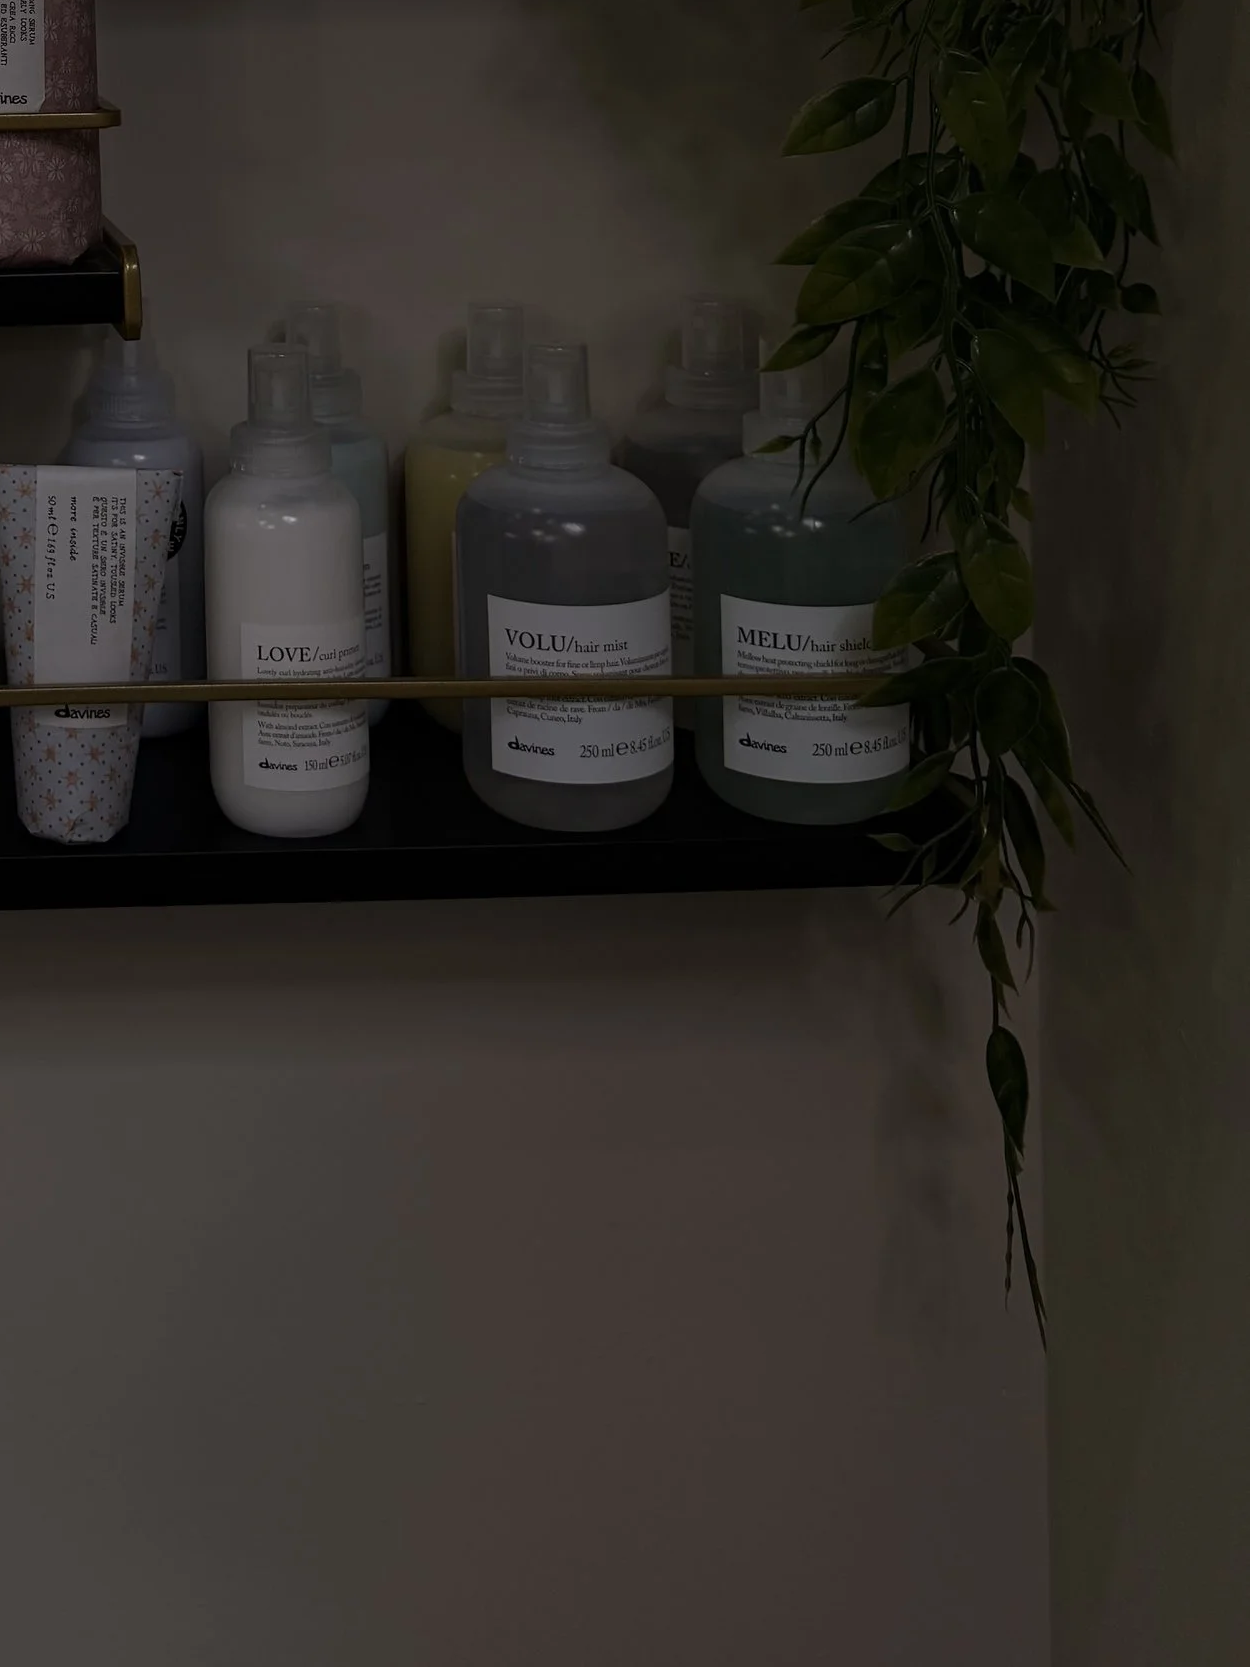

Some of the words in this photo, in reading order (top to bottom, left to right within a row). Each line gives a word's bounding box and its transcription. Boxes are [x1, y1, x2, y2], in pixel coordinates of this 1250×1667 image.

[48, 496, 56, 505] 50
[48, 507, 56, 520] ml
[120, 529, 126, 539] AN
[70, 528, 78, 561] inside
[603, 640, 628, 651] mist
[54, 702, 110, 718] davines
[508, 735, 554, 756] davines
[580, 745, 599, 758] 250
[602, 744, 614, 757] ml
[739, 733, 786, 754] davines
[813, 743, 832, 757] 250
[835, 743, 847, 756] ml
[259, 758, 298, 771] davines
[305, 760, 317, 771] 150
[319, 760, 328, 770] ml
